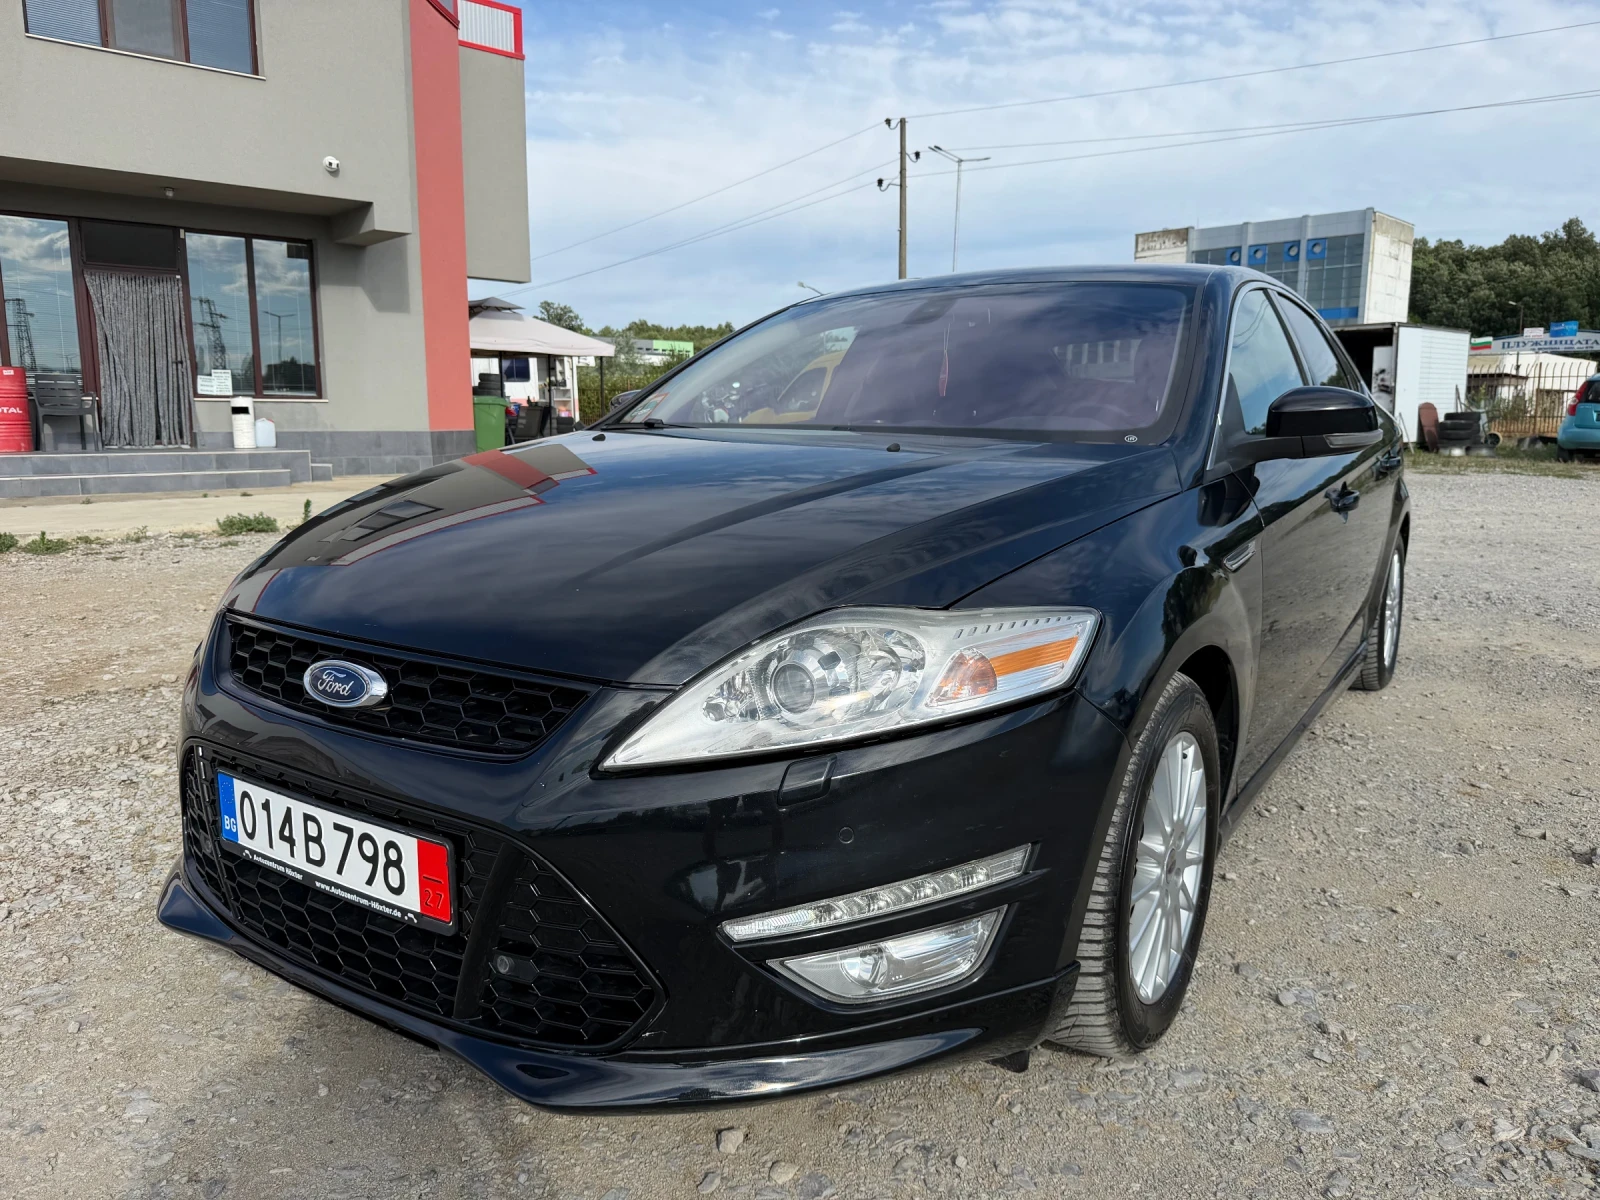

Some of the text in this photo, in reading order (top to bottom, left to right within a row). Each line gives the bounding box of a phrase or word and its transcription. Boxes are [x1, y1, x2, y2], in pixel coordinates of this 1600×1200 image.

[0, 406, 23, 414] TAL
[317, 669, 355, 696] Ford
[223, 814, 237, 833] BG
[239, 790, 406, 896] 014B798
[424, 888, 445, 910] 27
